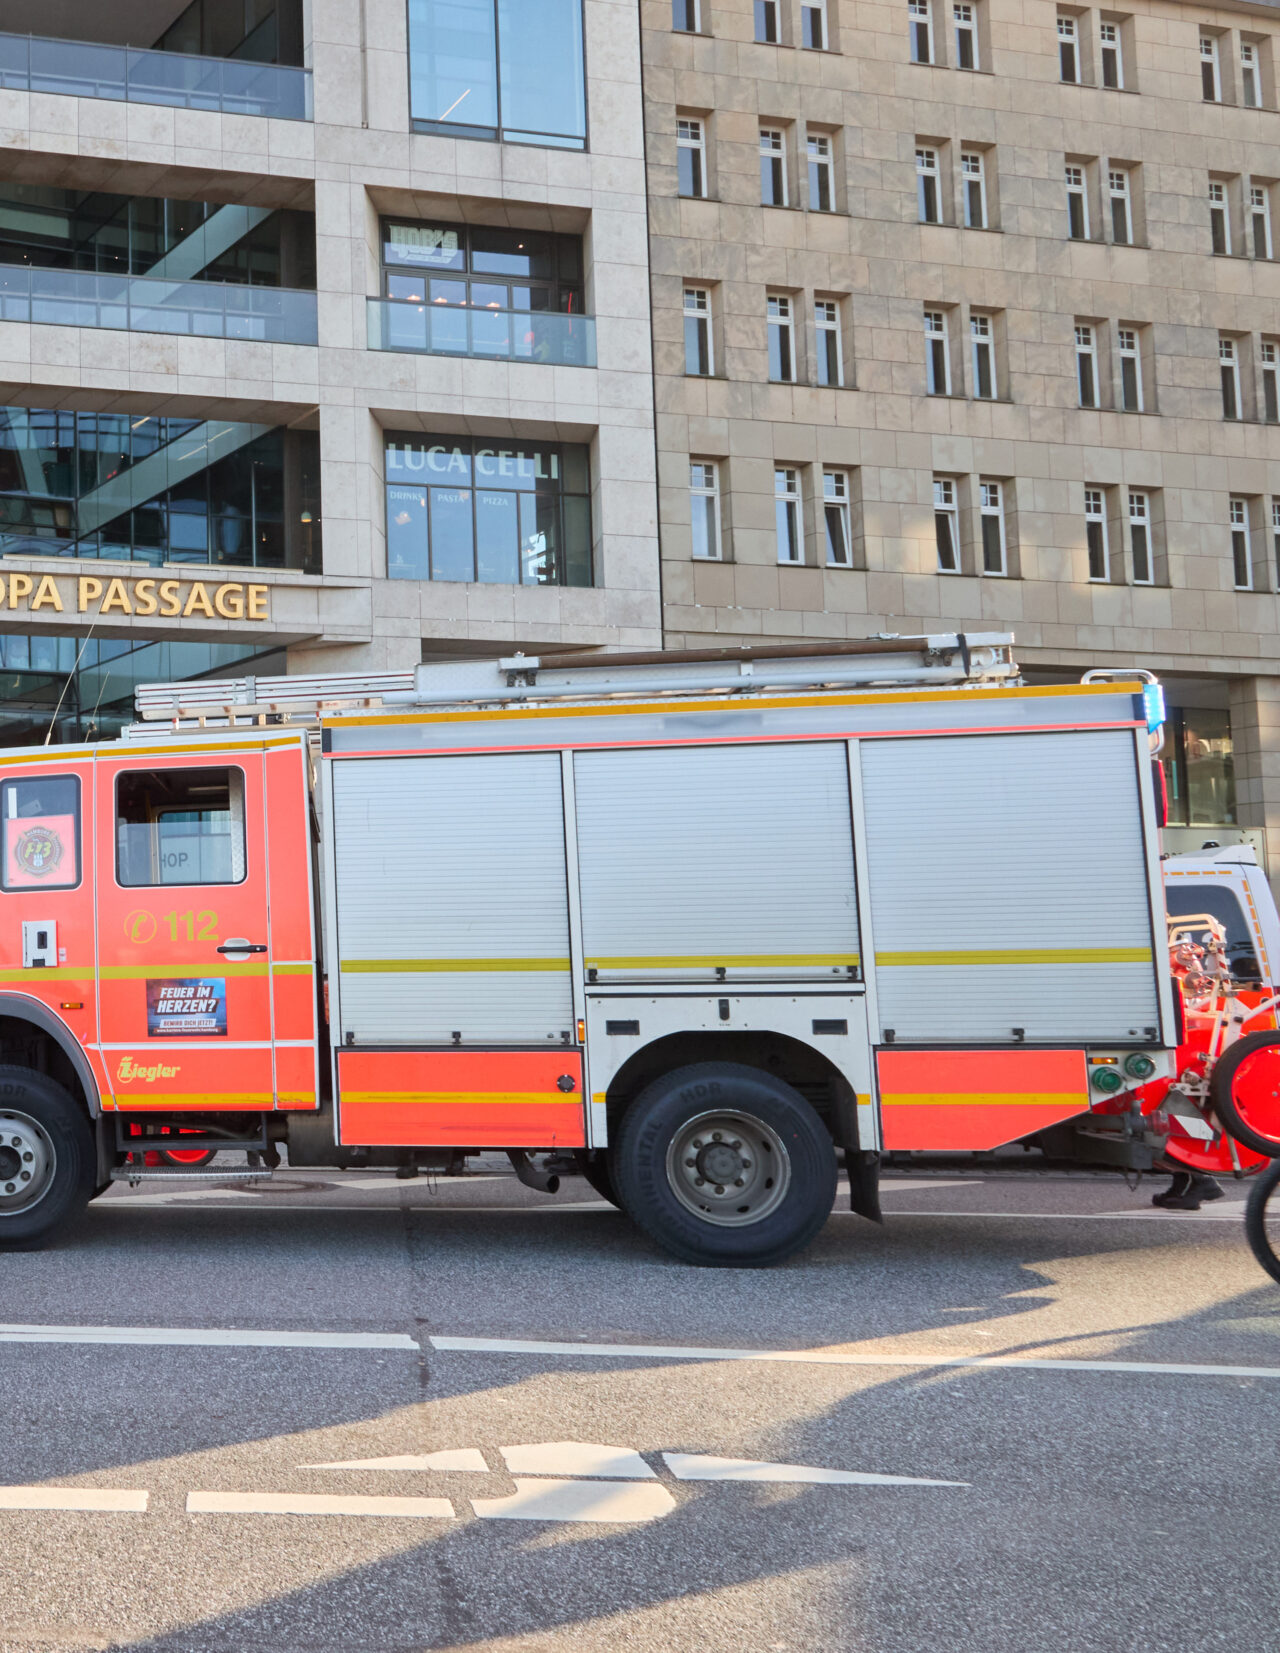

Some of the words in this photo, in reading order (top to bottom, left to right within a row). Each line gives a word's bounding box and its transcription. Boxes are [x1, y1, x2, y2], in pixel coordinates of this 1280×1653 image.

[388, 443, 468, 474] LUCA
[476, 449, 559, 480] CELLI
[390, 491, 423, 501] DRINKS
[437, 494, 466, 504] PASTA
[483, 496, 509, 506] PIZZA
[78, 576, 269, 620] PASSAGE
[163, 910, 219, 942] 112
[160, 987, 195, 999] FEUER
[196, 986, 211, 998] IM
[157, 999, 216, 1013] HERZEN?
[184, 1019, 197, 1027] DICH
[117, 1056, 181, 1084] Ziegler
